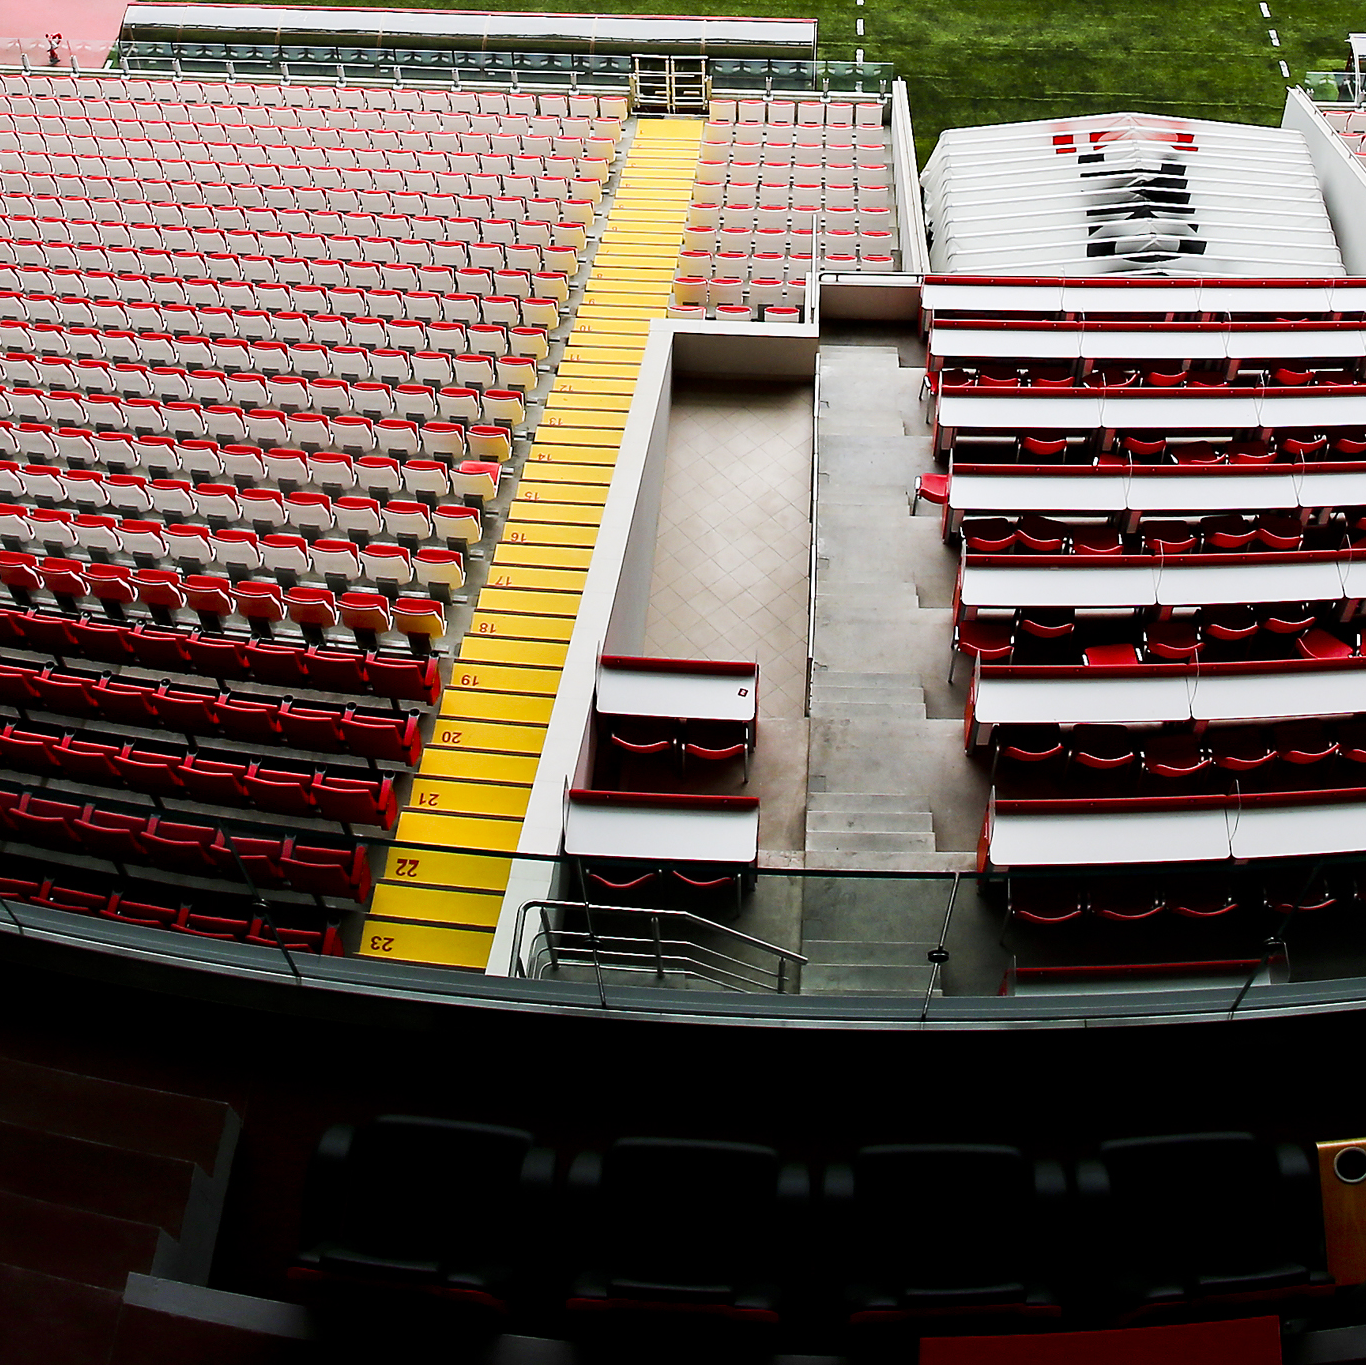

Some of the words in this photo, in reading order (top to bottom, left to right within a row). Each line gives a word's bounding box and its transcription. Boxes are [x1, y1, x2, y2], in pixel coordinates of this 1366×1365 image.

[569, 353, 581, 361] 11
[559, 384, 574, 392] 12
[548, 417, 563, 426] 13
[538, 453, 552, 461] 14
[524, 491, 540, 501] 15
[510, 532, 527, 542] 16
[494, 575, 512, 586] 17
[479, 622, 497, 633] 18
[461, 674, 480, 686] 19
[441, 731, 463, 744] 20
[418, 792, 440, 806] 21
[395, 858, 420, 877] 22
[370, 935, 395, 952] 23
